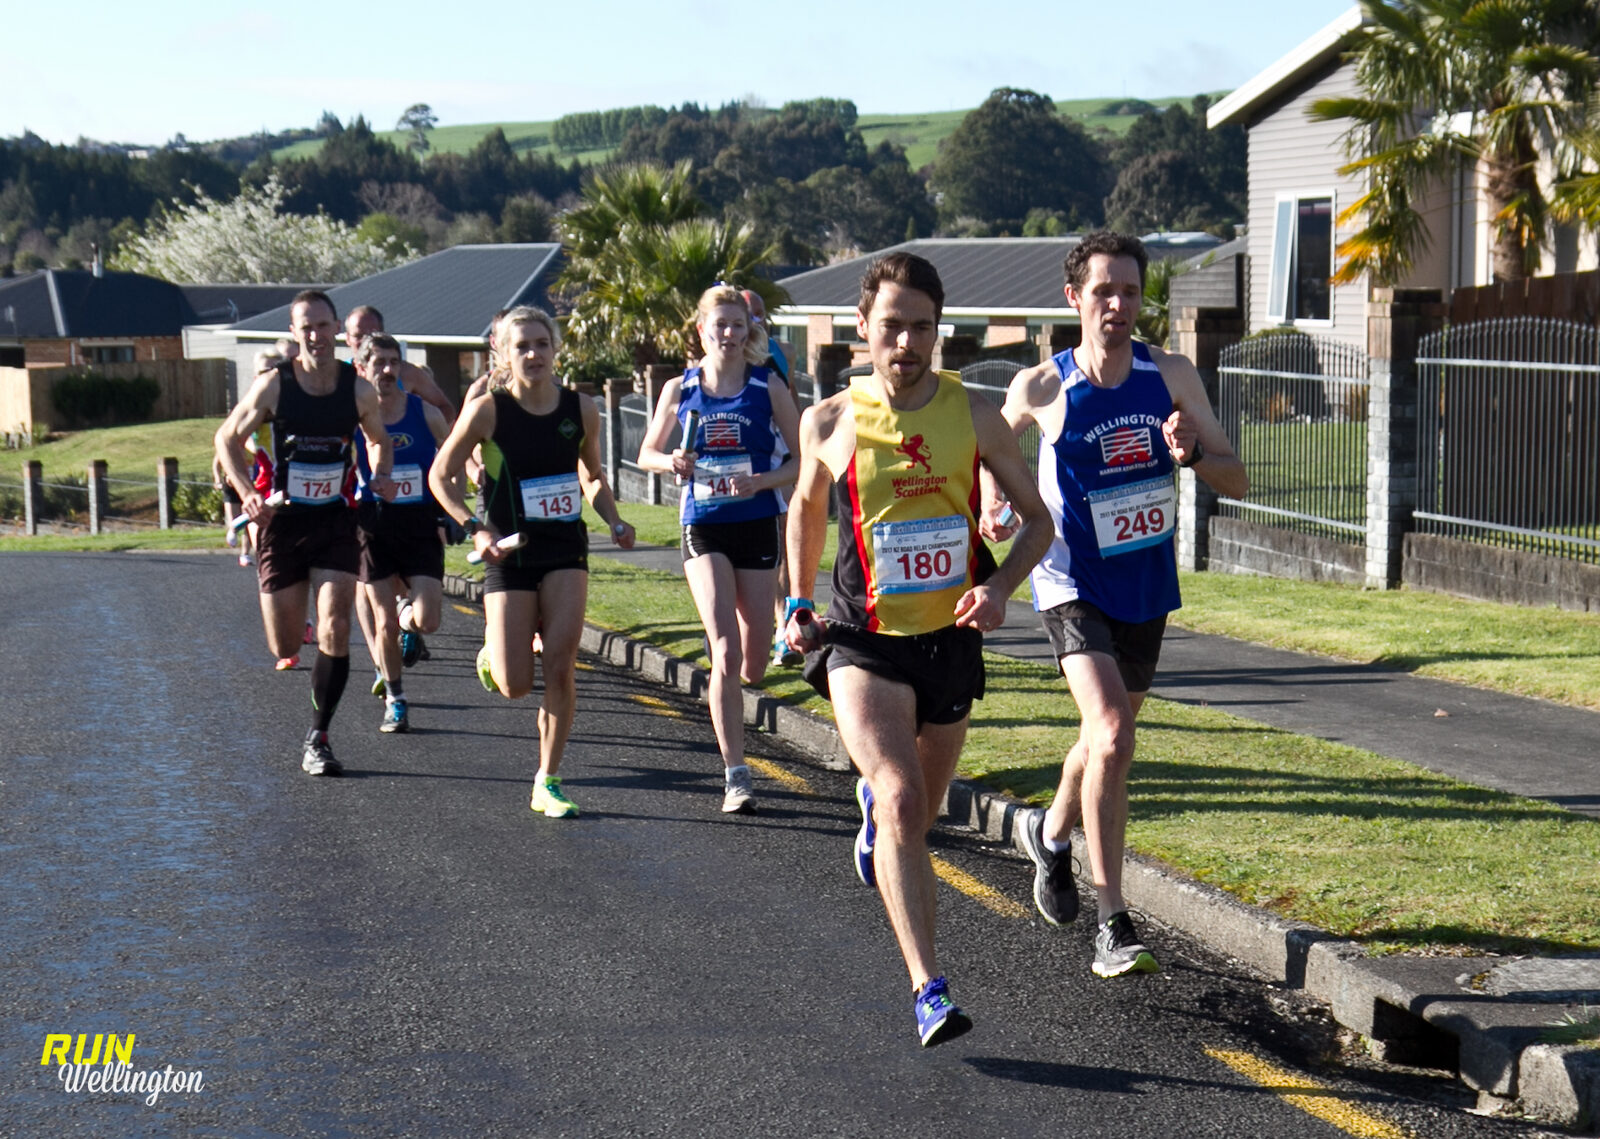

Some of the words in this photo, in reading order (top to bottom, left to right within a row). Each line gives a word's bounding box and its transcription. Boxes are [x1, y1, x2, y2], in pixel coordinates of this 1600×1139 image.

[1083, 413, 1162, 444] WELLINGTON
[1122, 461, 1147, 472] ATHLETIC
[1147, 459, 1159, 467] CLUB
[302, 481, 332, 498] 174
[393, 480, 412, 496] 70
[892, 475, 947, 488] Wellington
[894, 485, 942, 499] Scottish
[538, 495, 573, 517] 143
[1113, 507, 1165, 542] 249
[896, 549, 952, 580] 180
